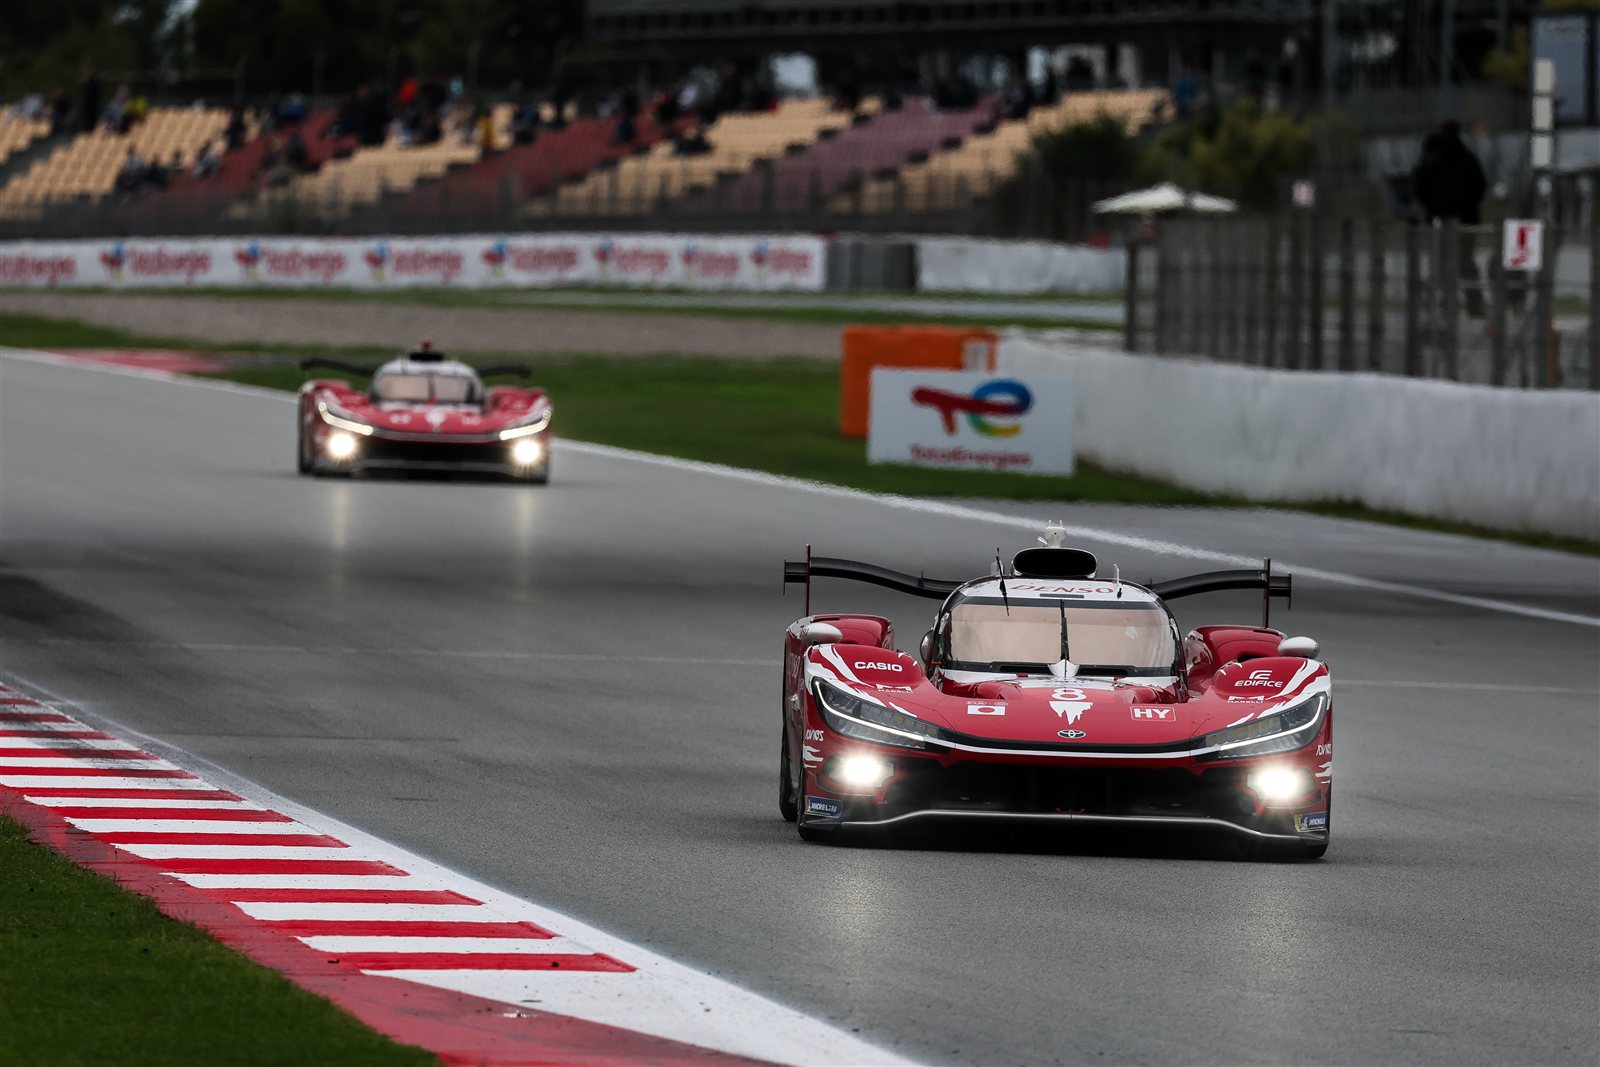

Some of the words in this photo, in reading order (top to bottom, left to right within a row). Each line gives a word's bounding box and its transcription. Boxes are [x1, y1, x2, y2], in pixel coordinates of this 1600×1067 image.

[854, 661, 903, 672] CASIO
[1234, 680, 1283, 688] EDIFICE
[1051, 688, 1087, 700] 8
[1133, 708, 1170, 719] HY
